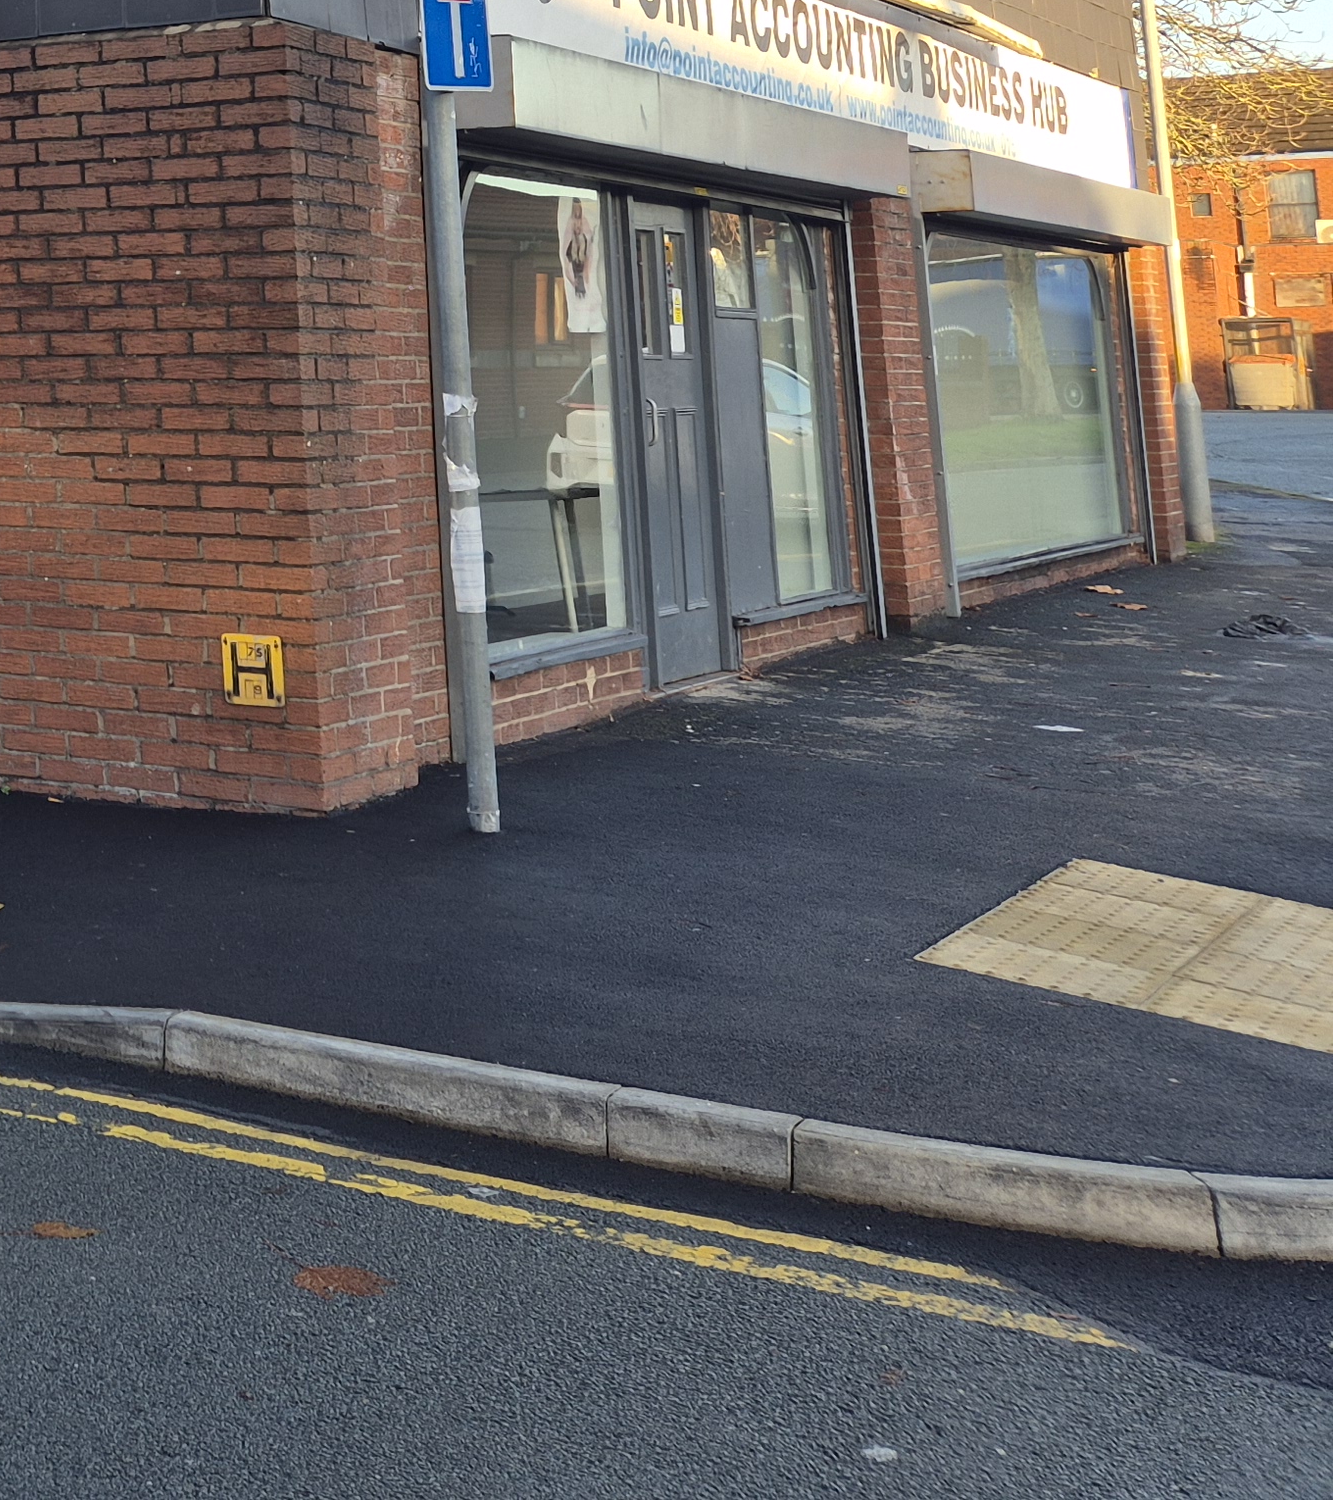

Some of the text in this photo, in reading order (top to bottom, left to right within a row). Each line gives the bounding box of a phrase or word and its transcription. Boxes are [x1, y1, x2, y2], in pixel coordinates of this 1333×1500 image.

[624, 26, 834, 113] info@pointaccounting.co.uk
[847, 94, 996, 153] www.pointaccounting.co.uk
[918, 39, 1025, 124] BUSINESS
[1030, 76, 1068, 135] HUB
[230, 641, 275, 699] H
